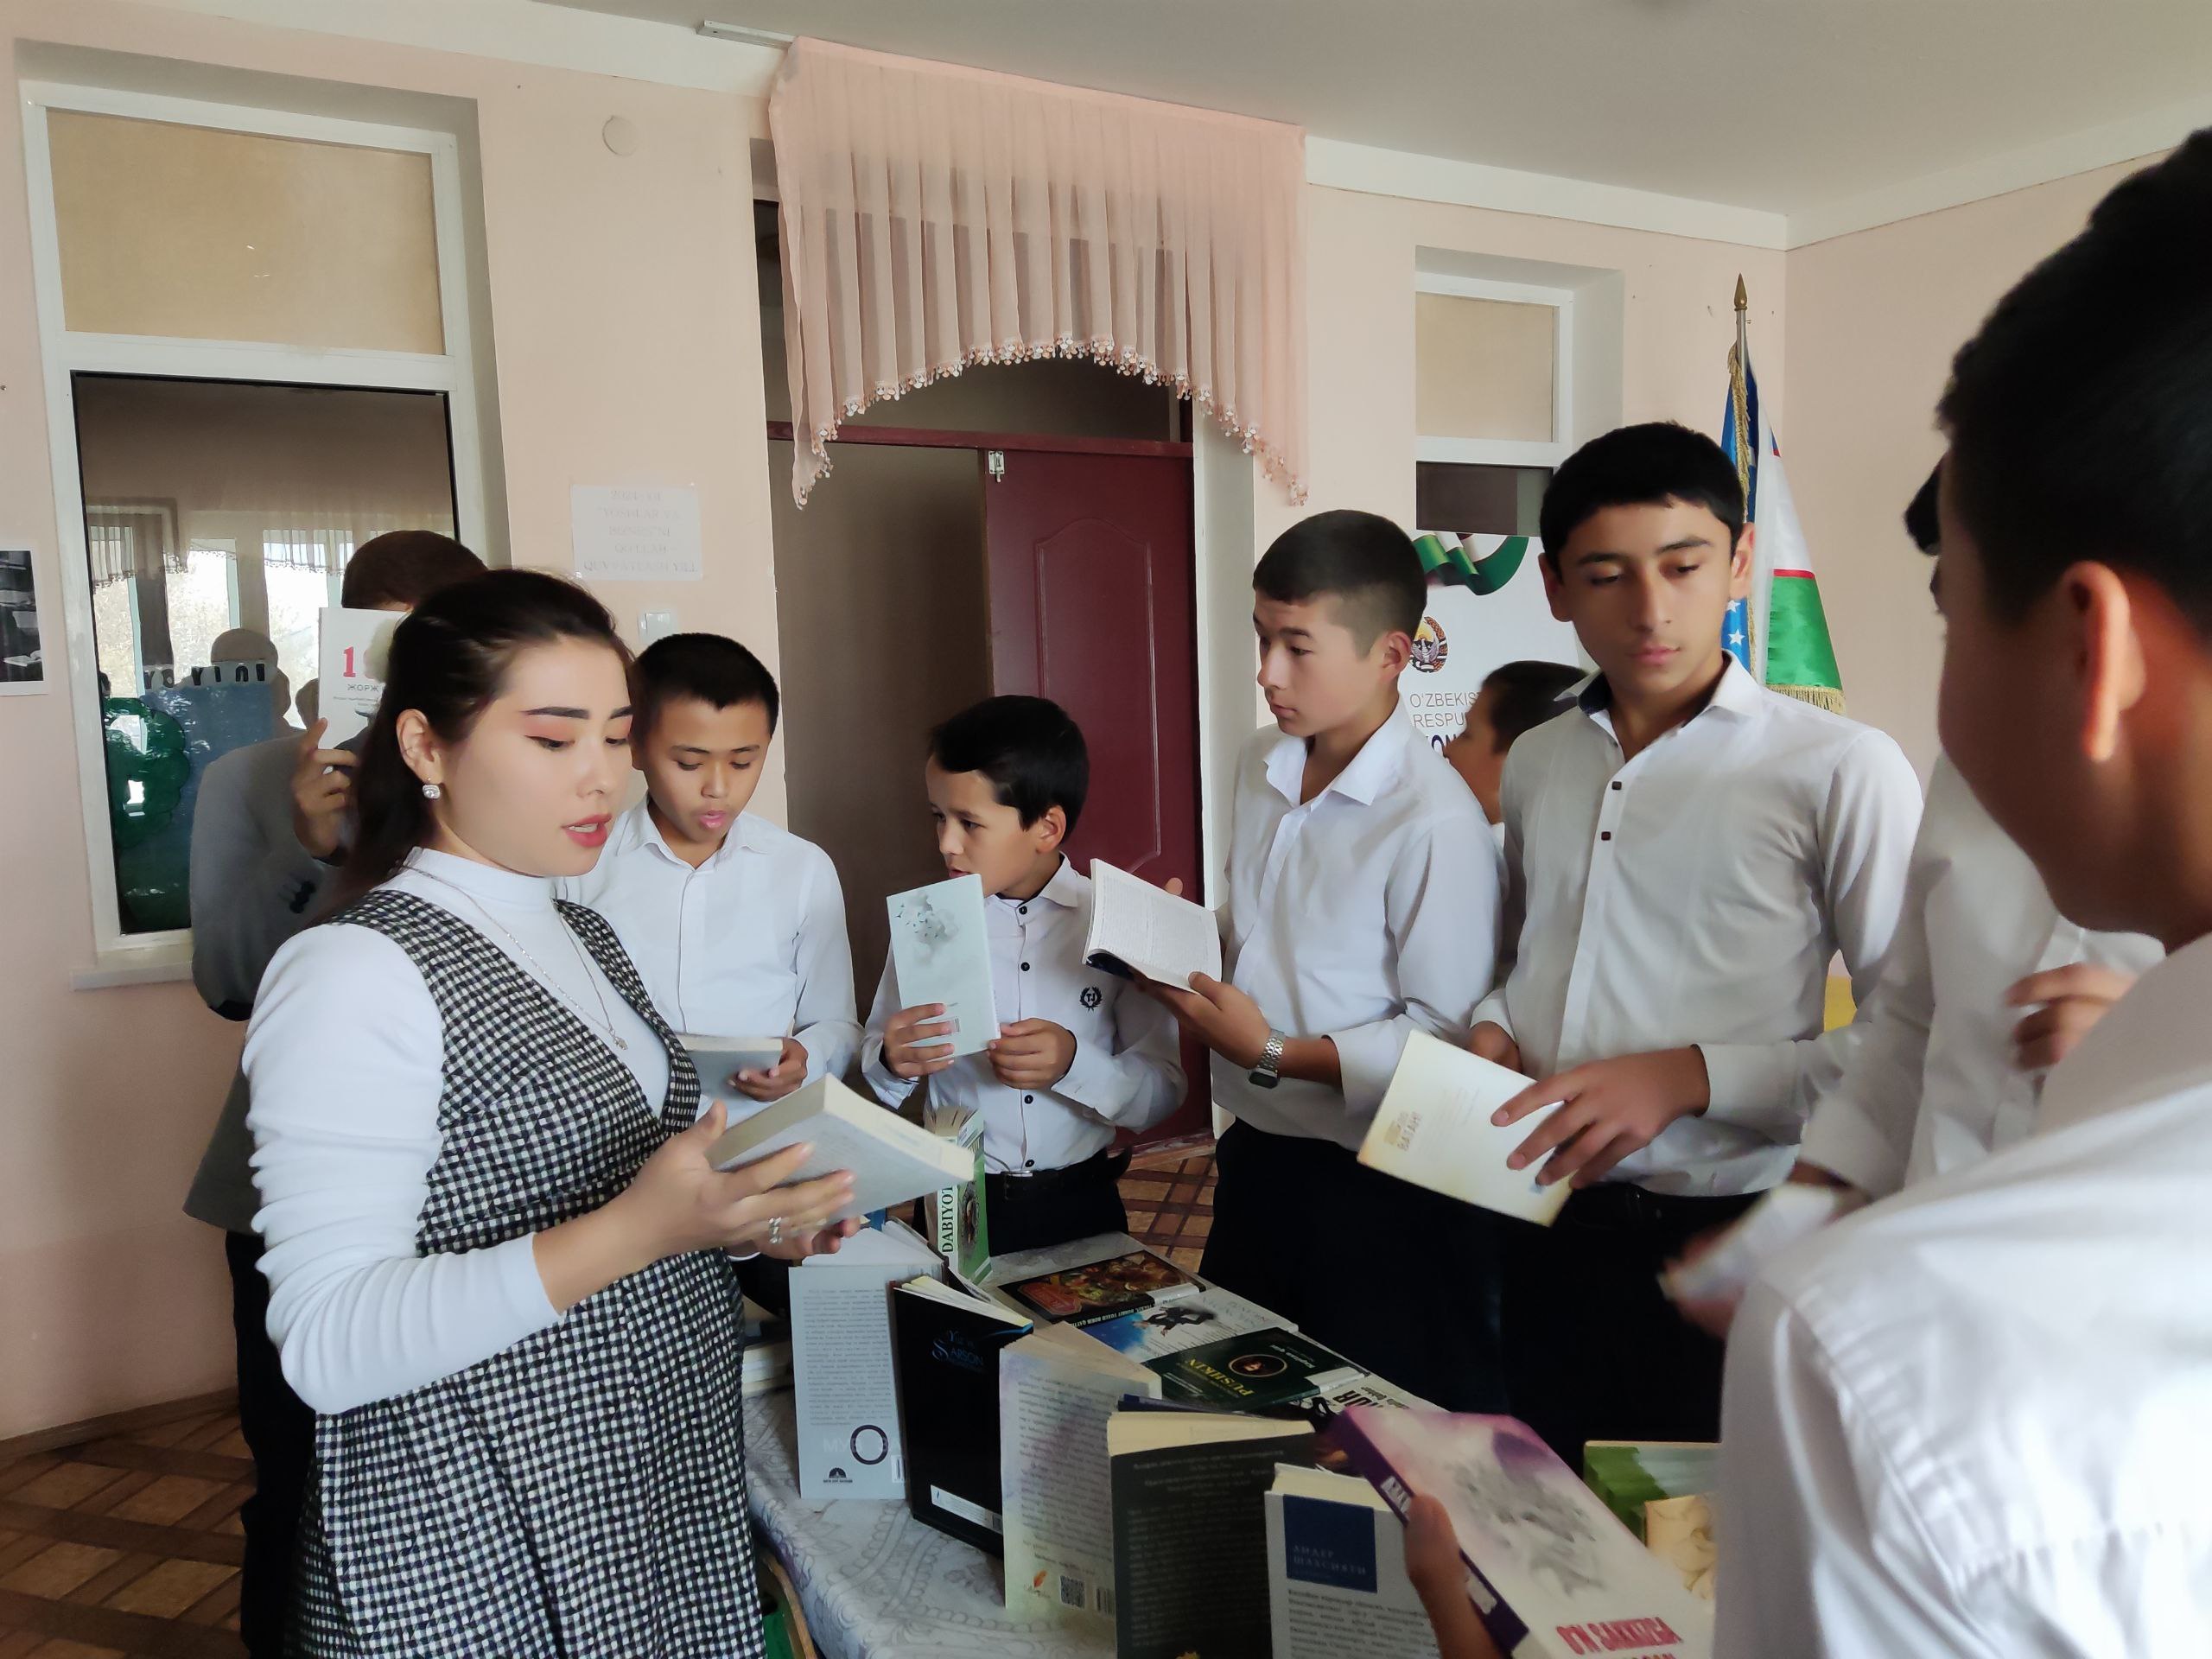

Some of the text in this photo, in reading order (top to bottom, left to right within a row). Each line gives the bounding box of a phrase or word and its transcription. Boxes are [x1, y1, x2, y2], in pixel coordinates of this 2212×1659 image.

[347, 683, 379, 692] ЖОРЖ
[1086, 993, 1096, 1002] TJ
[1189, 1358, 1255, 1397] PUSHKIN
